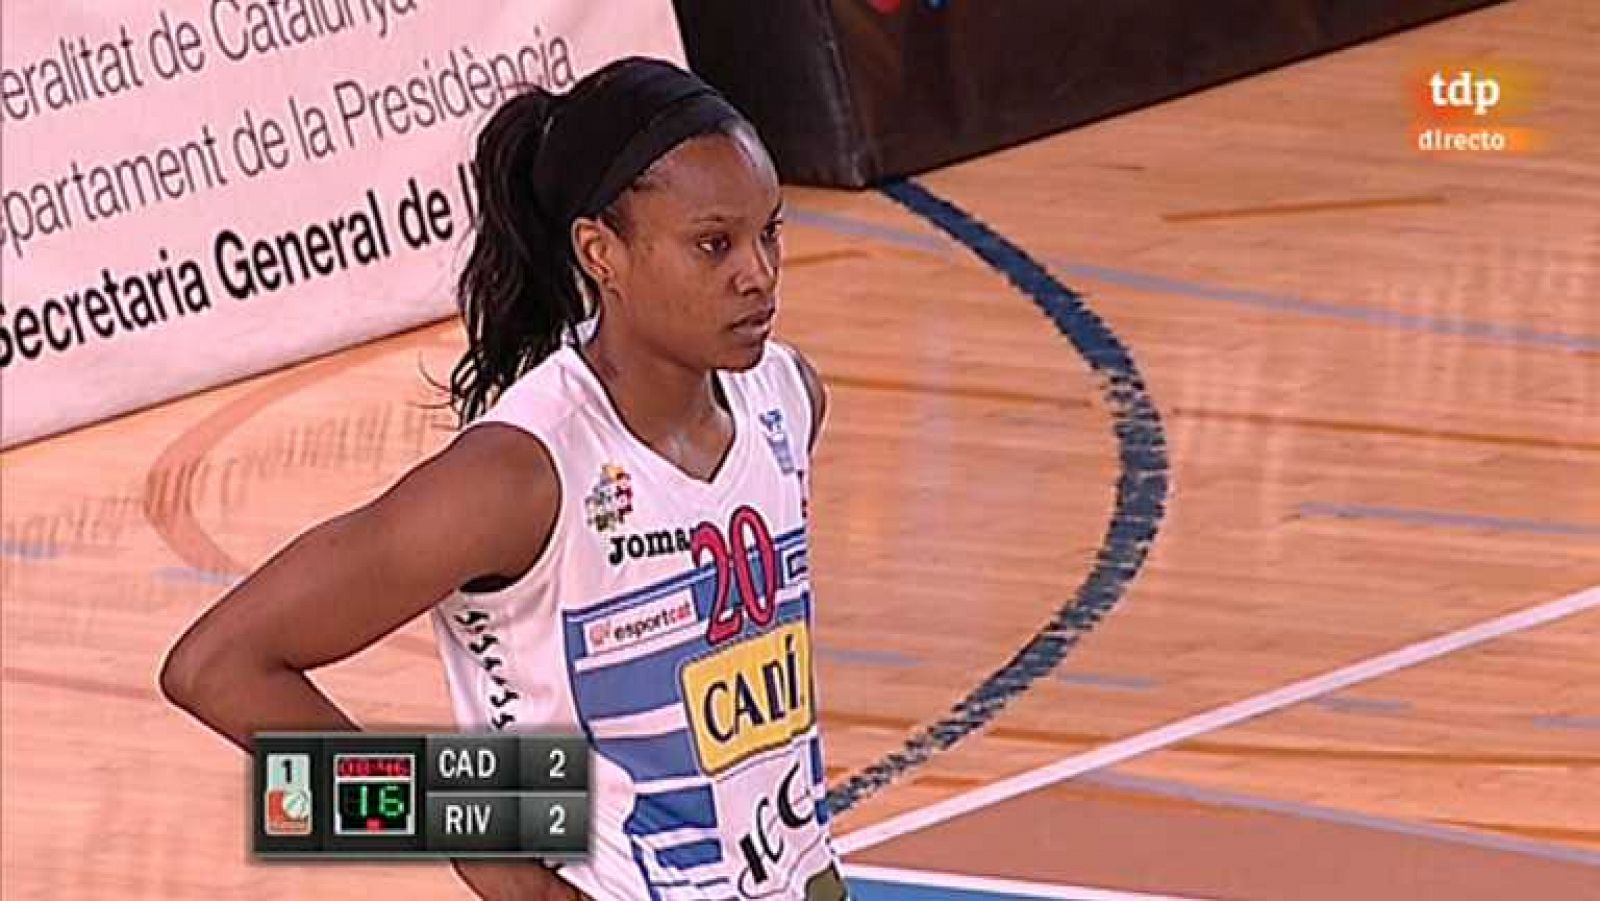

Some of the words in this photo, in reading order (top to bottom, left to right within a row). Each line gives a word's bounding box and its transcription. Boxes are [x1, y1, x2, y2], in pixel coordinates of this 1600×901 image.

[149, 8, 206, 79] de
[0, 125, 228, 258] partament
[232, 107, 290, 178] de
[288, 95, 336, 161] la
[333, 25, 575, 149] Presidència
[213, 188, 390, 300] General
[399, 177, 454, 249] de
[692, 506, 776, 646] 20
